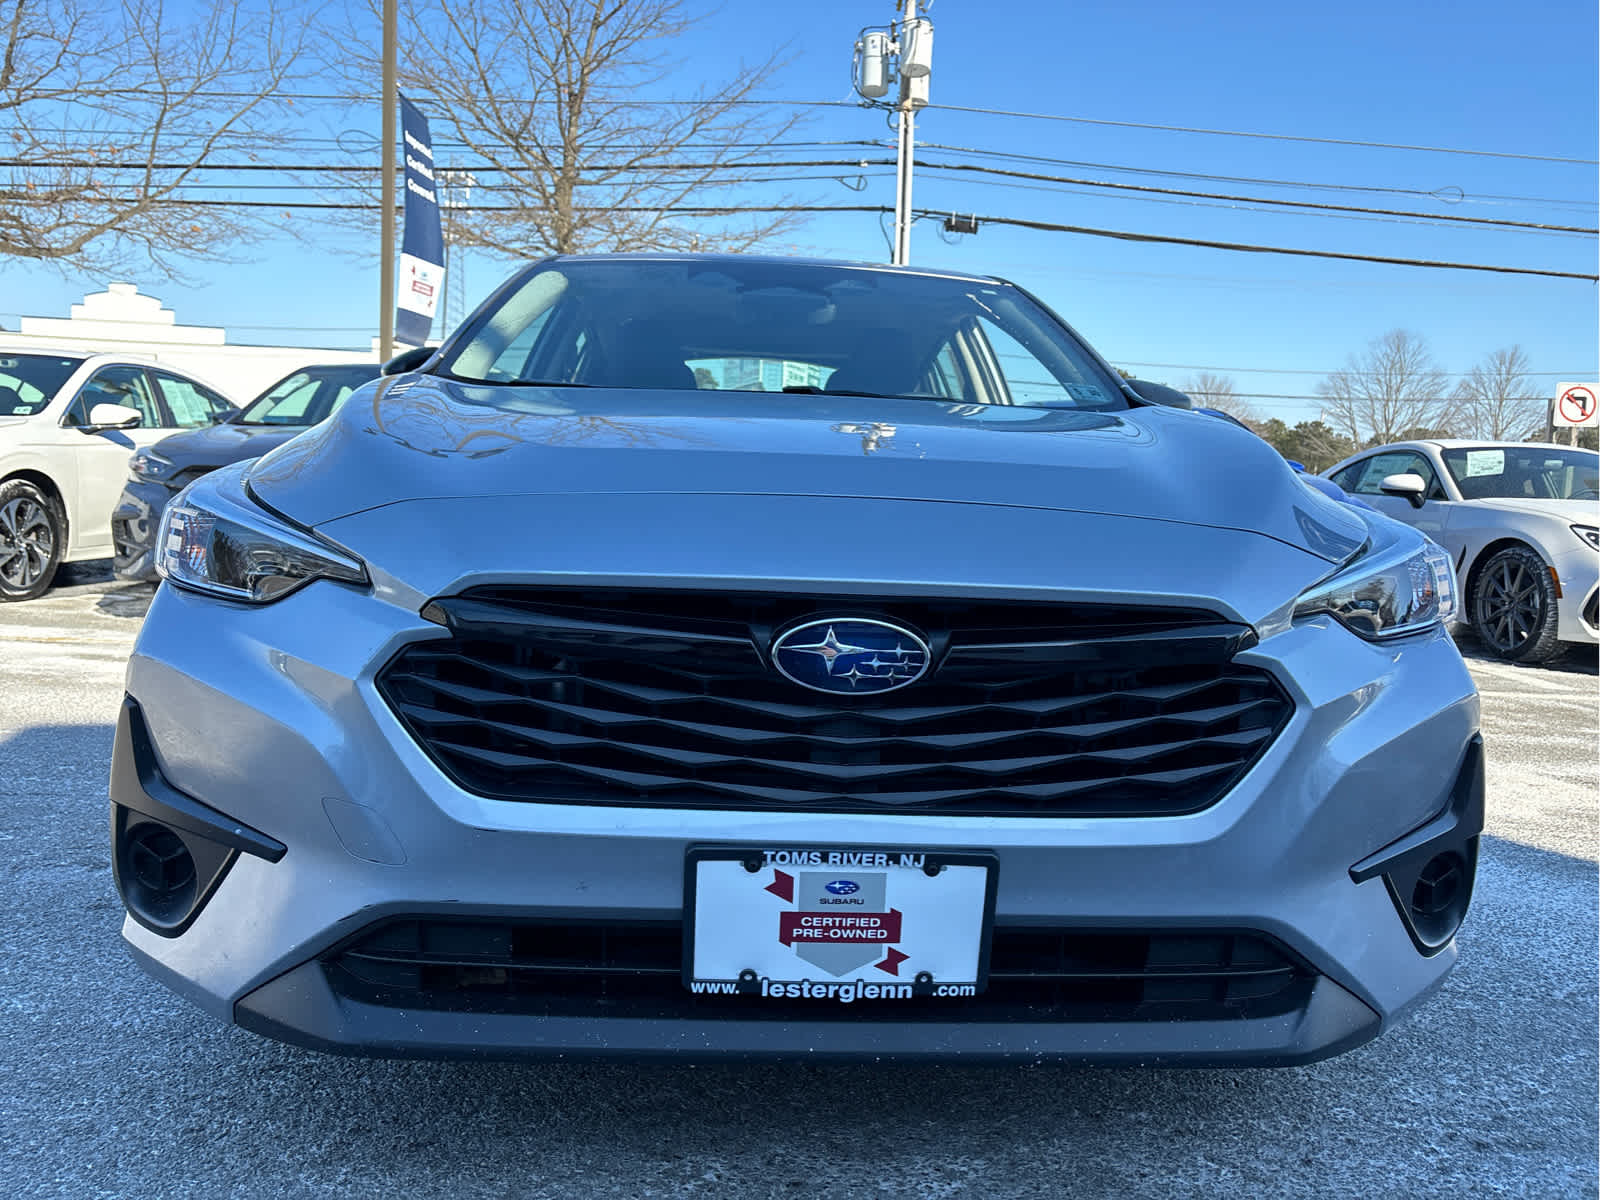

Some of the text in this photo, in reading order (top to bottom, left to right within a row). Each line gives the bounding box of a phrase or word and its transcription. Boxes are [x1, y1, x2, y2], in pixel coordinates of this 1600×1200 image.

[763, 851, 822, 865] TOMS
[900, 854, 926, 868] NJ
[801, 917, 881, 927] CERTIFIED
[793, 928, 888, 939] PRE-OWNED
[690, 979, 977, 1003] www. lesterglenn .com
